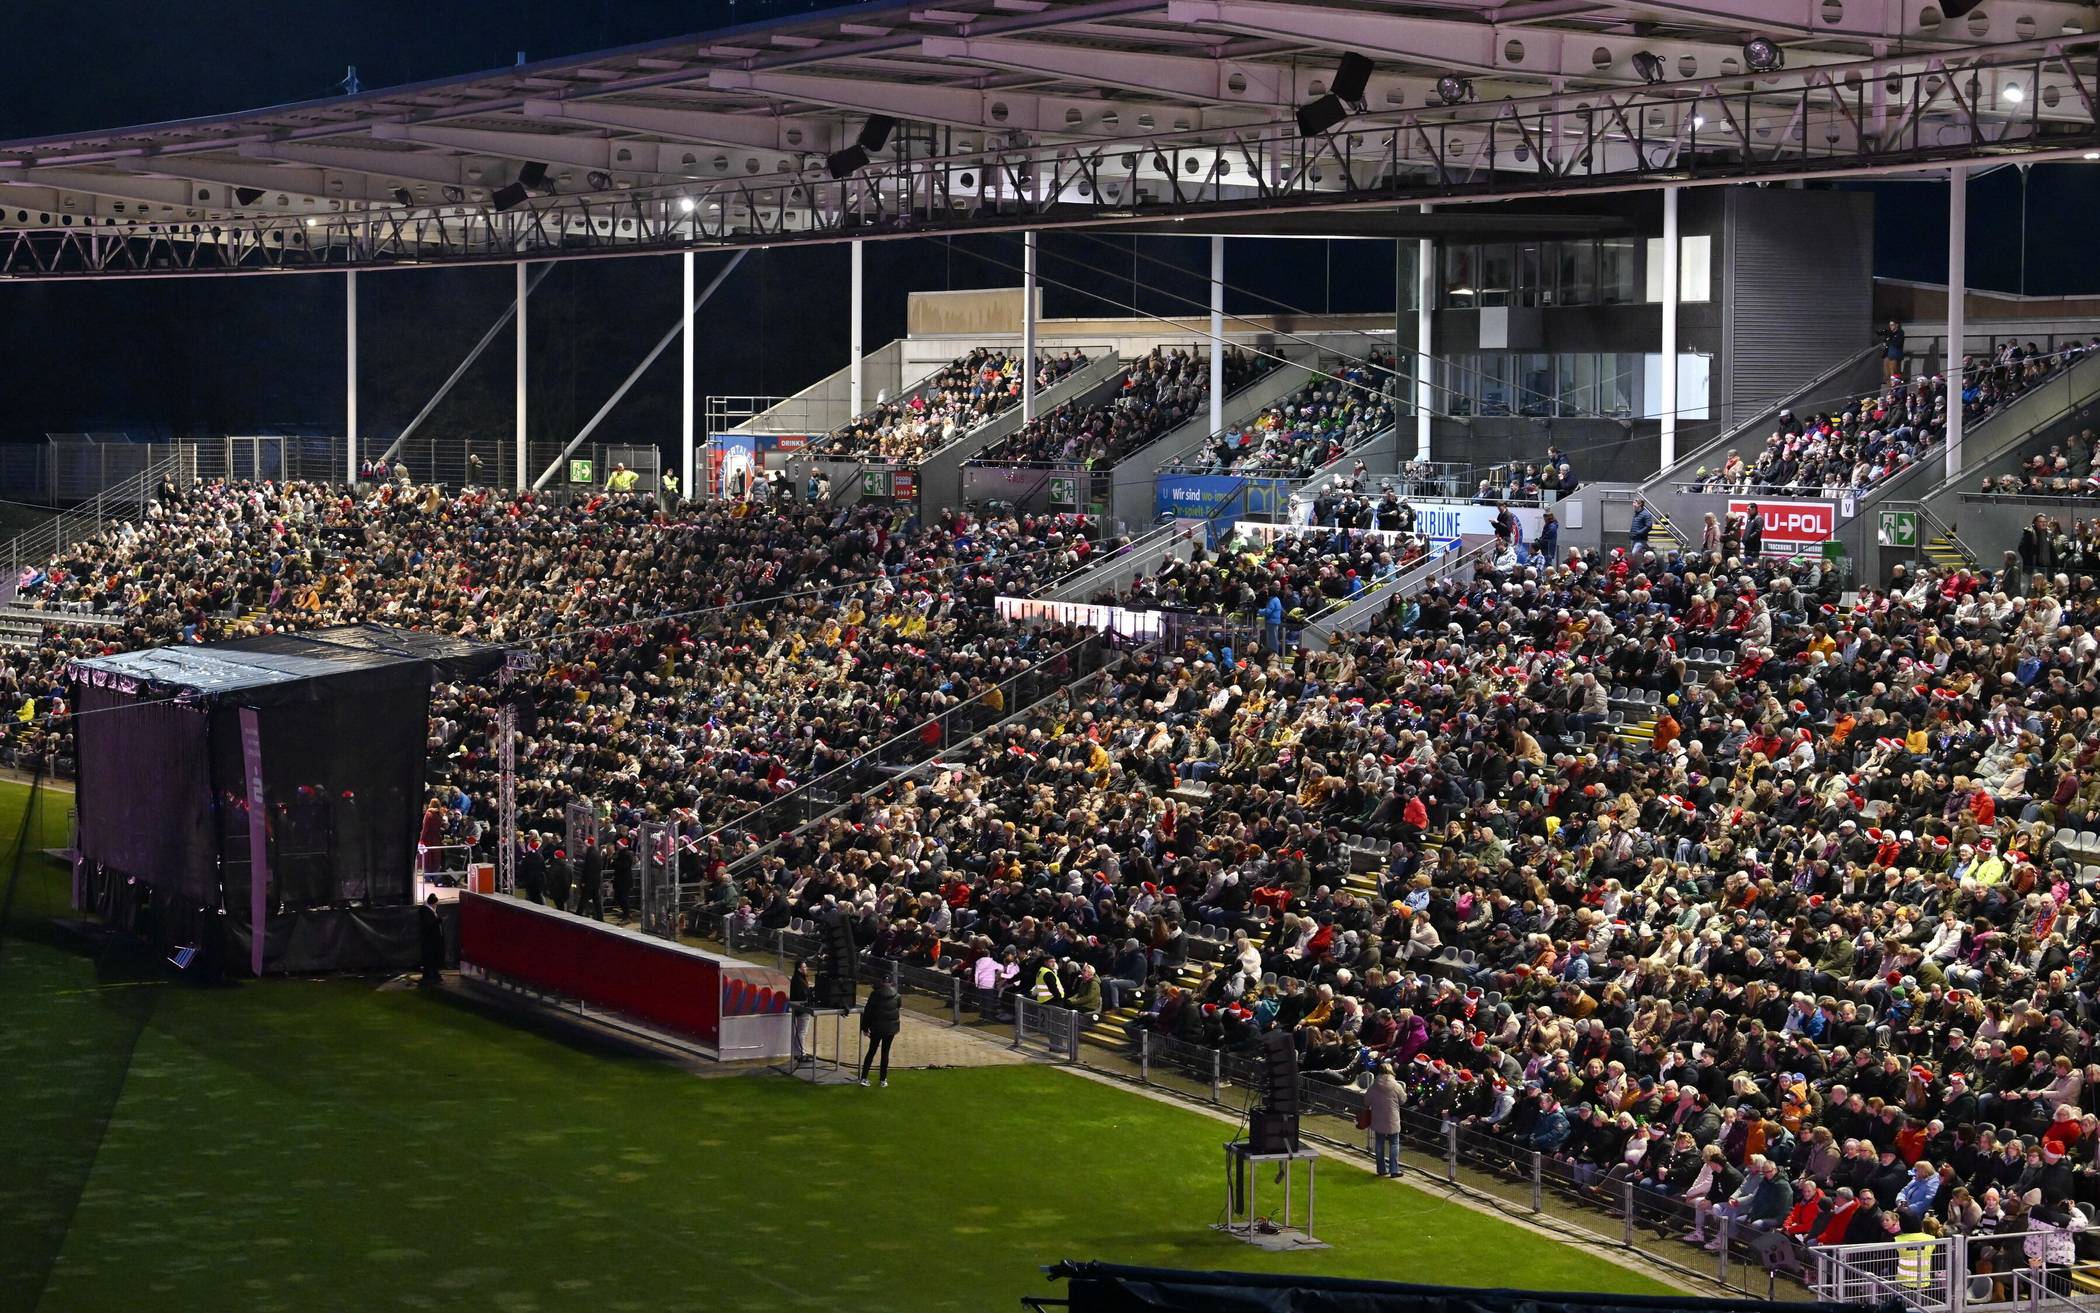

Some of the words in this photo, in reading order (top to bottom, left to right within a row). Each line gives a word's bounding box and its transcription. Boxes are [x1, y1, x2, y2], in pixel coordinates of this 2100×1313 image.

[1162, 487, 1169, 499] U
[1172, 487, 1185, 501] Wir
[1185, 488, 1200, 501] sind
[1844, 503, 1851, 513] V
[1415, 506, 1461, 537] RIBÜNE
[1735, 511, 1827, 533] BU-POL
